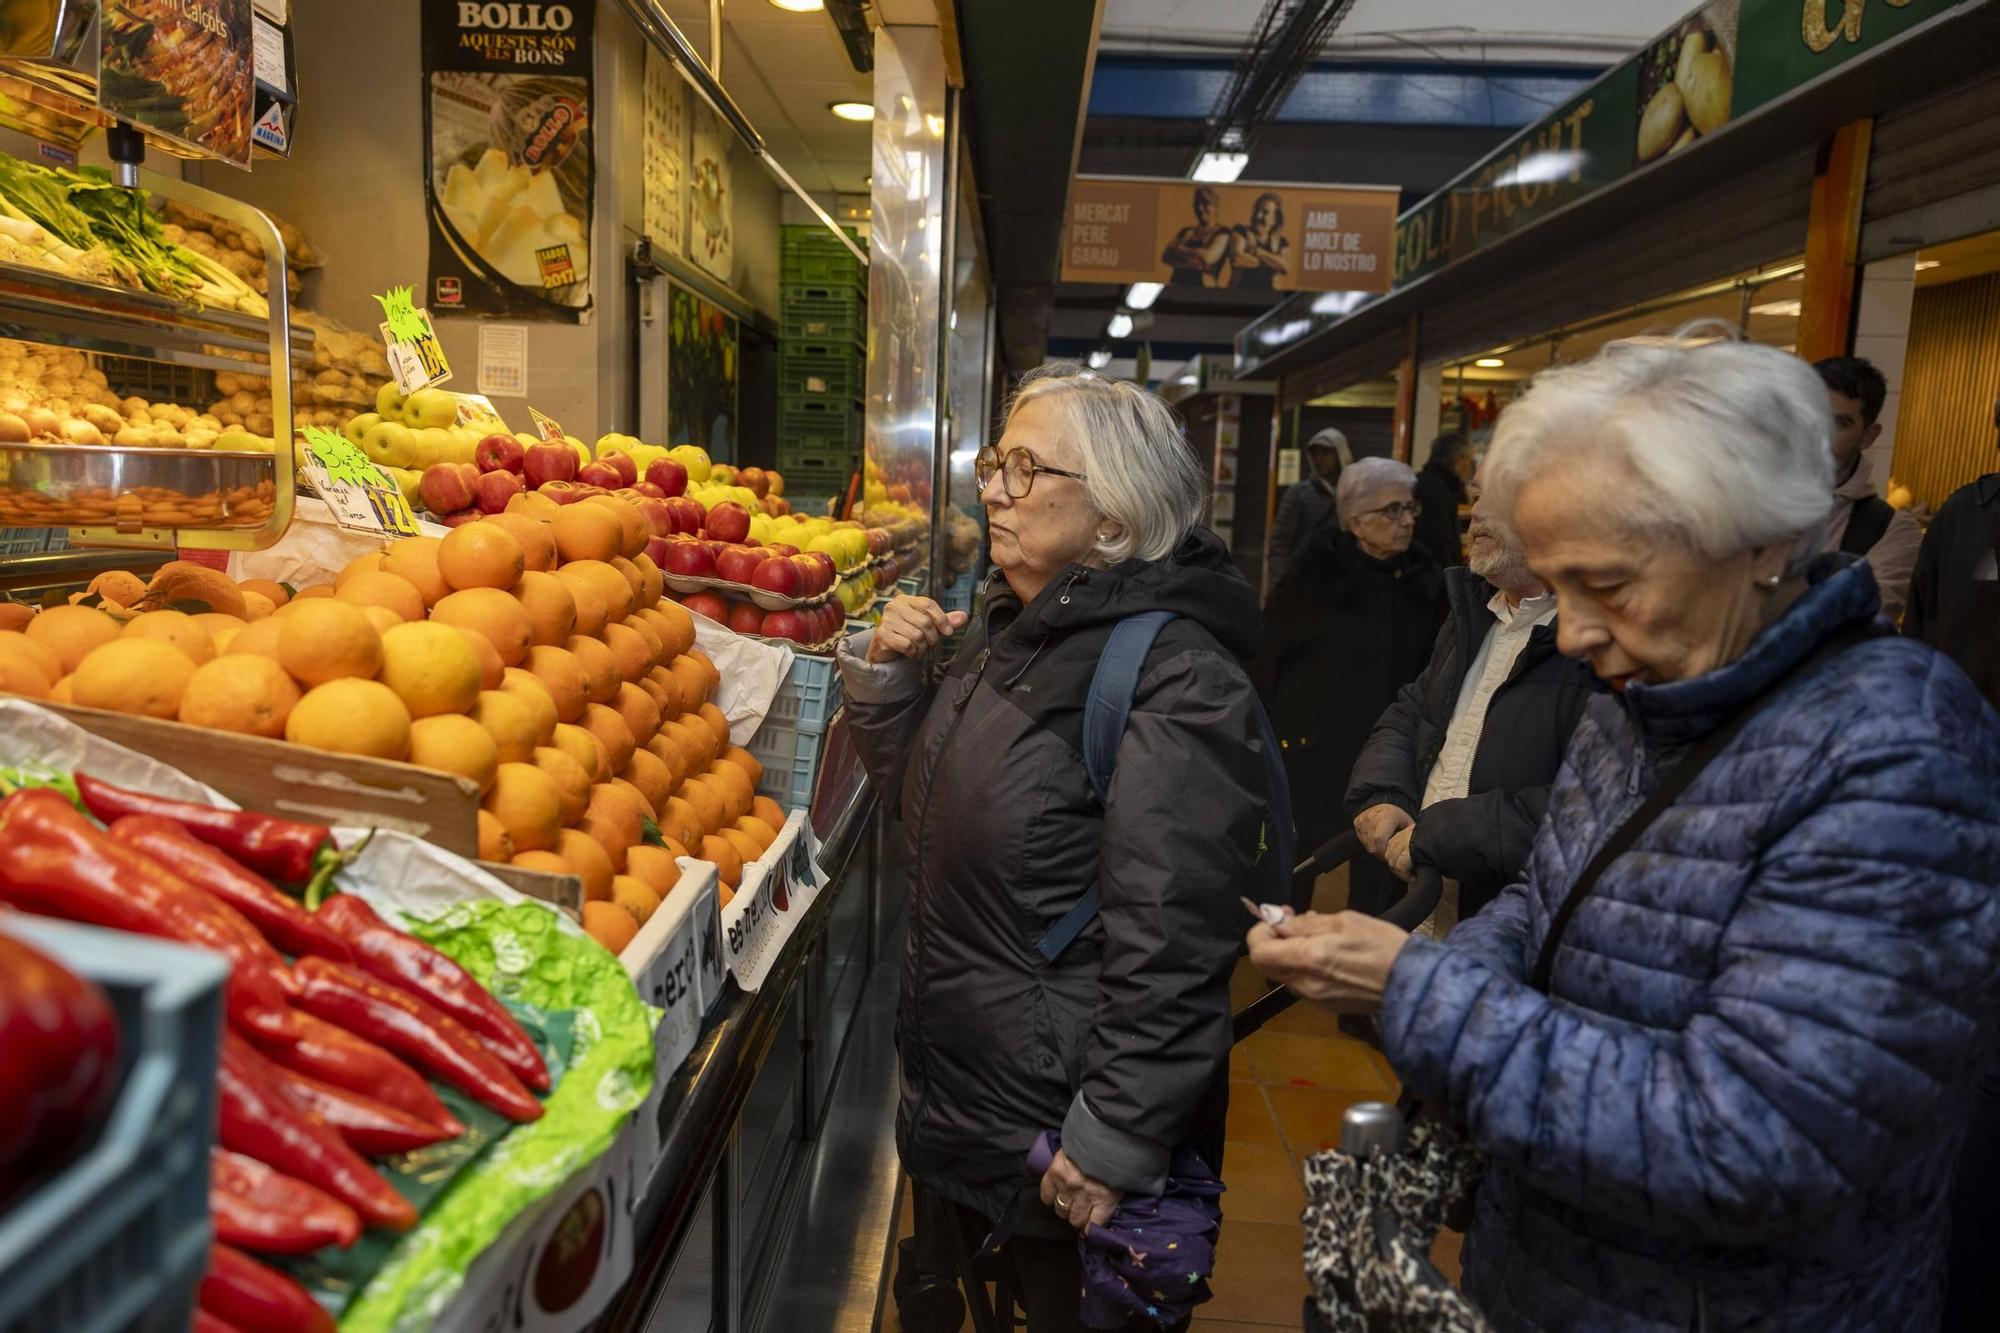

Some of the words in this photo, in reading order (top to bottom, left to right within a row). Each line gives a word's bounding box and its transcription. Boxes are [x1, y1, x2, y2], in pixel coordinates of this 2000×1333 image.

[457, 2, 574, 31] BOLLO
[459, 33, 538, 51] AQUESTS
[541, 32, 576, 50] SÓN
[485, 48, 511, 60] ELS
[514, 49, 565, 65] BONS
[1073, 202, 1131, 225] MERCAT
[1306, 210, 1338, 230] AMB
[1072, 224, 1109, 245] PERE
[1304, 232, 1340, 251] MOLT
[1342, 232, 1361, 250] DE
[1303, 252, 1323, 271] LO
[1323, 253, 1377, 273] NOSTRO
[544, 269, 575, 289] 2017
